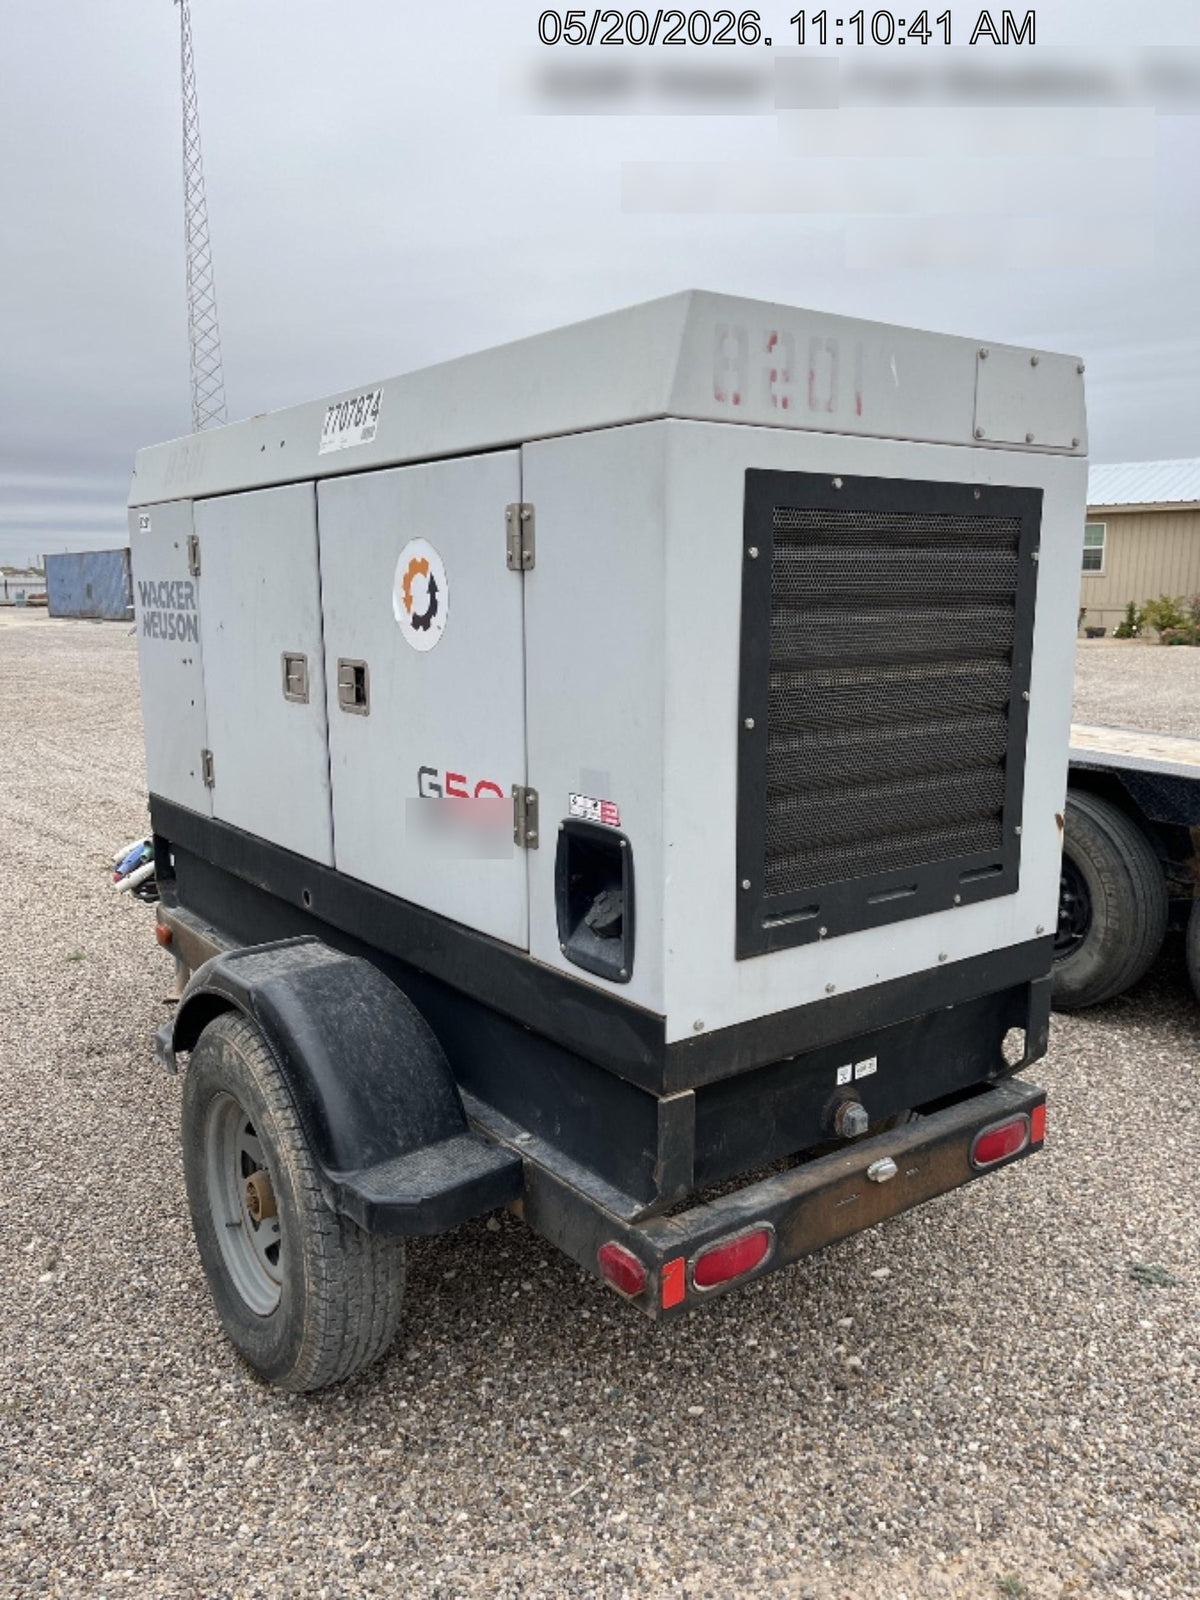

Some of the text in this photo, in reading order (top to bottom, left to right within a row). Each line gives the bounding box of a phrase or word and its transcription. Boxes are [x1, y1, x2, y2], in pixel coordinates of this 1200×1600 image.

[323, 391, 381, 435] 7707874
[138, 580, 196, 610] WACKER
[143, 611, 198, 643] NEUSON
